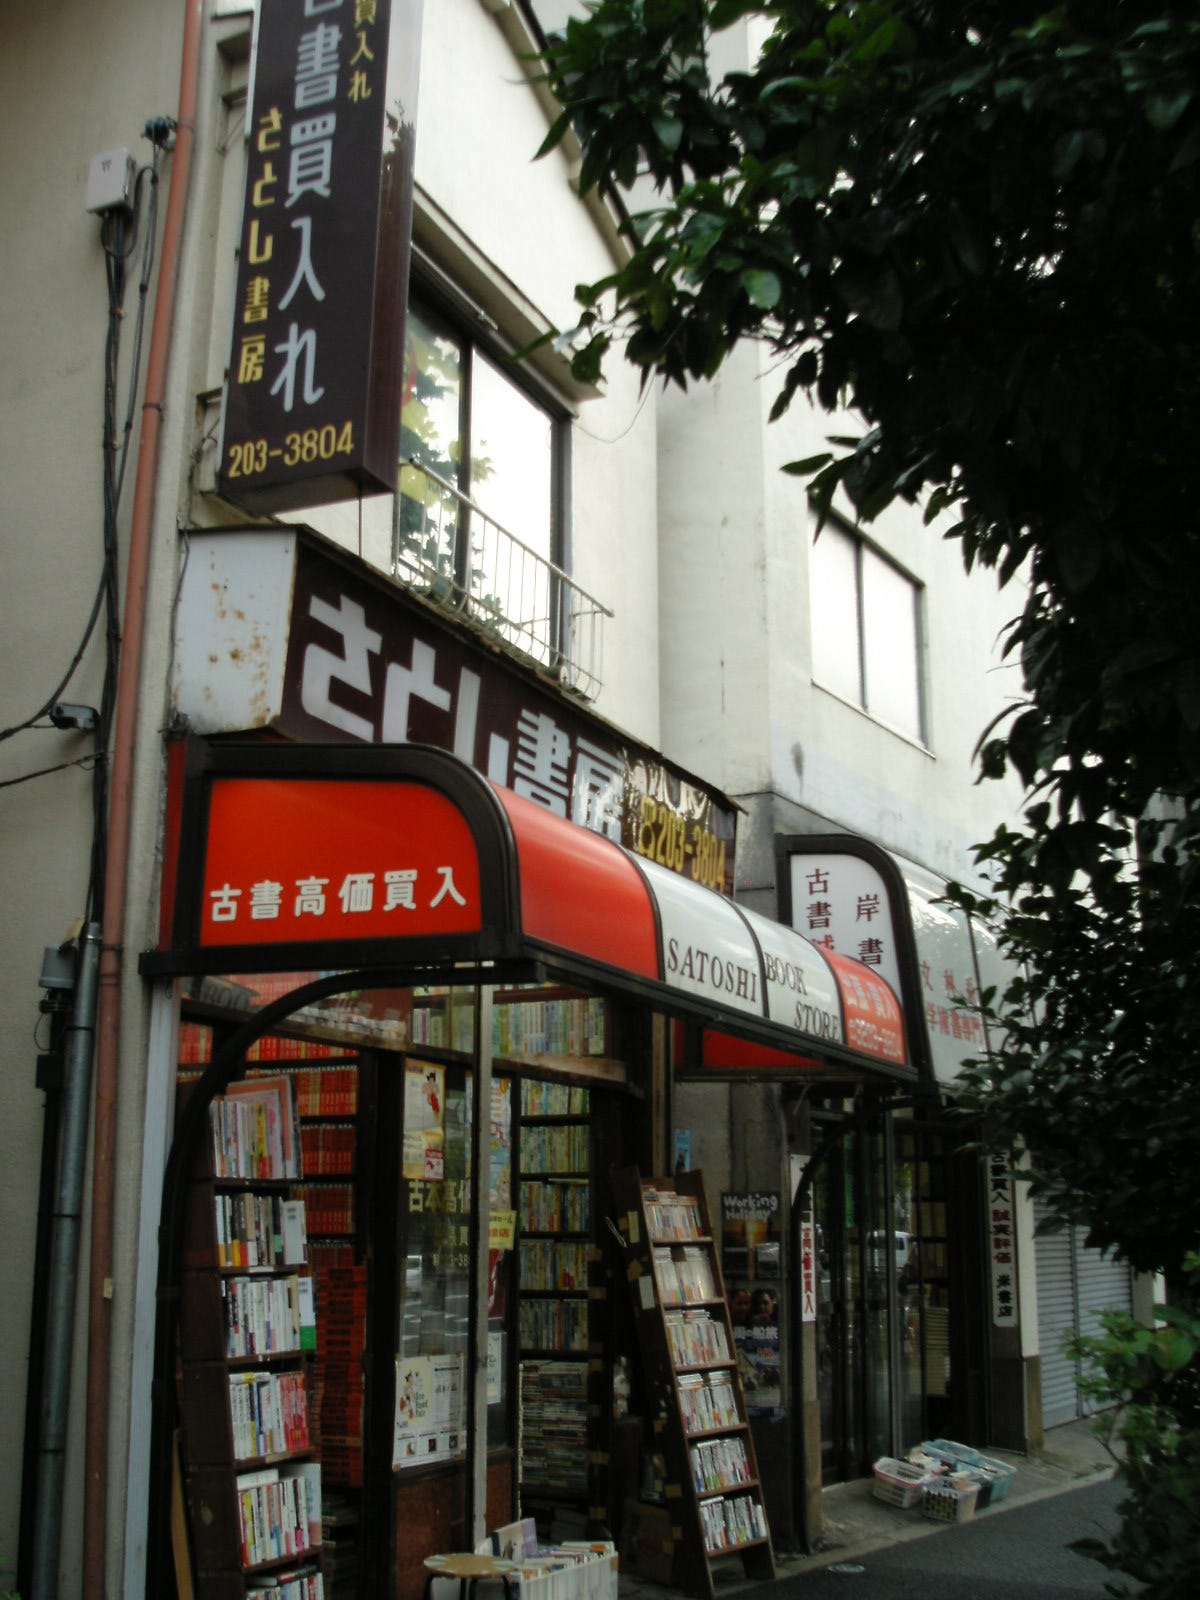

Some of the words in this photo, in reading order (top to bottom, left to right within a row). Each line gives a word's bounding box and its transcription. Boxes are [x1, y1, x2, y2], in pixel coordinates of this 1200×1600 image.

[237, 106, 284, 385] さとし書房
[228, 421, 355, 479] 203-3804
[210, 866, 467, 923] 古書高価買入
[667, 937, 758, 1003] SATOSHI
[764, 951, 808, 997] BOOK
[794, 1000, 840, 1045] STORE
[723, 1194, 778, 1210] Working
